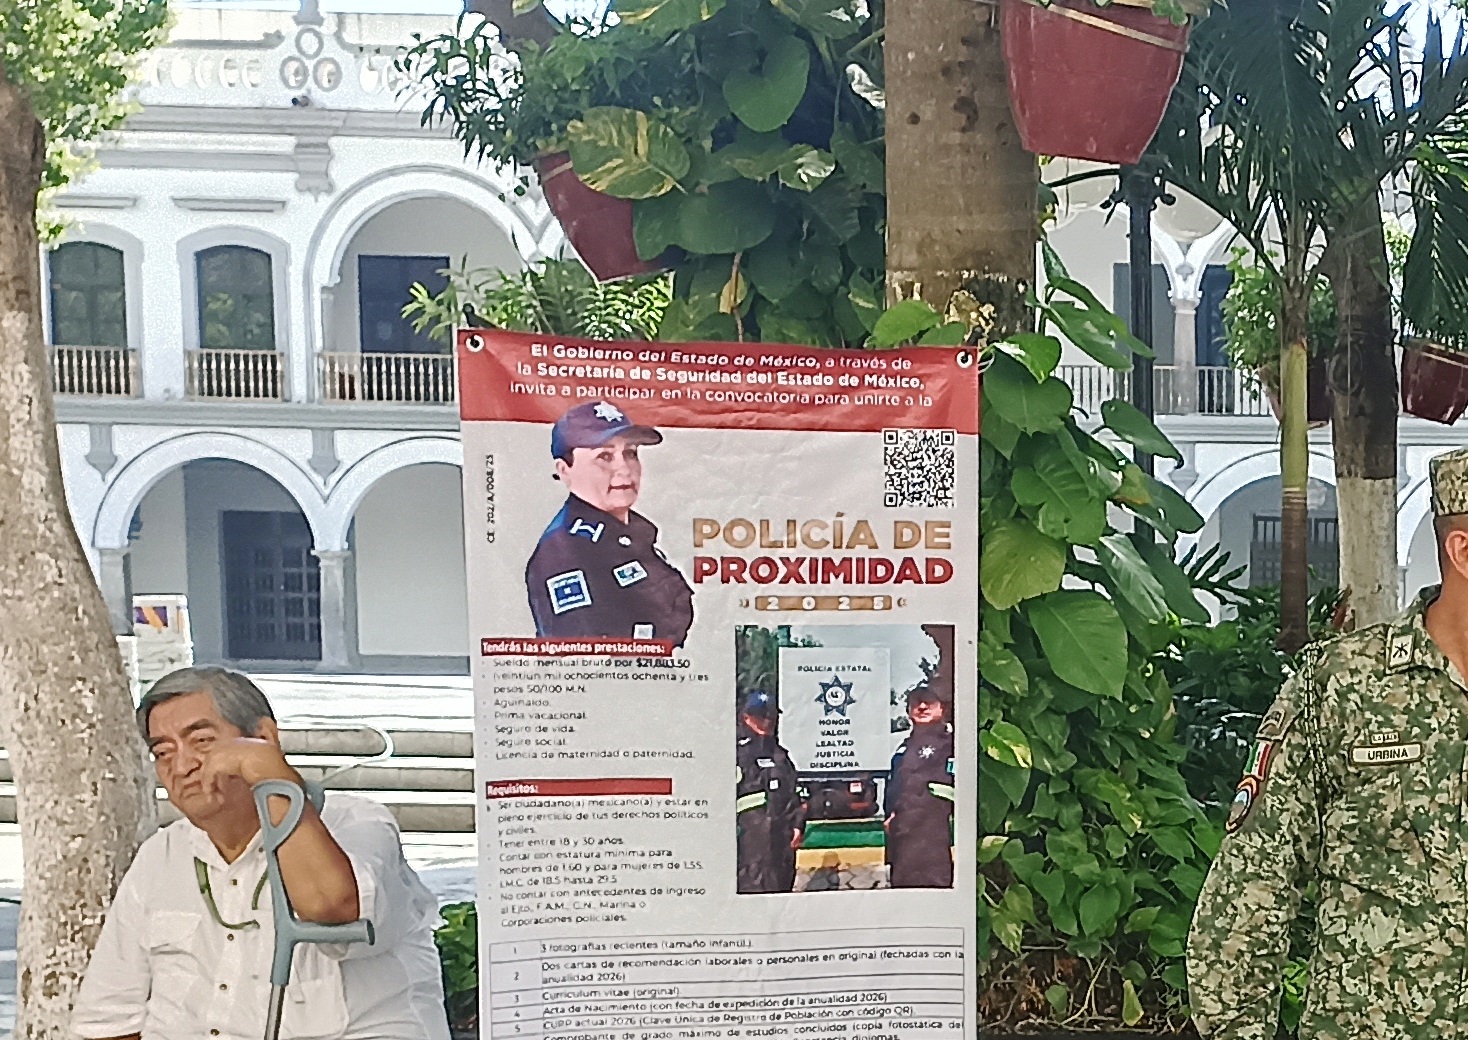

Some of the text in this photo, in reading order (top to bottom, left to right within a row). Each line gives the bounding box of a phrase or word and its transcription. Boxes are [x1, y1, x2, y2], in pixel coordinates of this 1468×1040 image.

[532, 344, 912, 369] El Gobierno del Estado de México, a través de
[517, 362, 924, 390] la Secretaría de Seguridad del Estado de México,
[562, 385, 570, 396] a
[577, 384, 655, 400] participar
[662, 387, 682, 399] en
[688, 387, 700, 400] la
[705, 389, 809, 405] convocatoria
[815, 394, 849, 405] para
[855, 394, 900, 405] unirte
[905, 396, 913, 406] a
[920, 394, 932, 407] la
[693, 512, 952, 550] POLICÍA DE
[693, 556, 954, 586] PROXIMIDAD
[483, 642, 665, 654] Tendrás las siguientes prestaciones:
[535, 724, 548, 733] de
[541, 751, 554, 759] de
[558, 749, 619, 758] maternidad
[1368, 748, 1408, 760] URBINA
[488, 784, 539, 796] Requisitos:
[499, 840, 524, 848] Tener
[560, 837, 570, 846] 18
[573, 839, 578, 847] y
[582, 837, 595, 845] 30
[604, 988, 630, 997] vitae
[544, 1005, 565, 1015] Acta
[568, 1005, 581, 1013] de
[584, 1002, 647, 1012] Nacimiento
[675, 999, 704, 1009] fecha
[708, 999, 720, 1009] de
[782, 996, 795, 1006] de
[797, 995, 805, 1006] la
[808, 994, 858, 1004] anualidad
